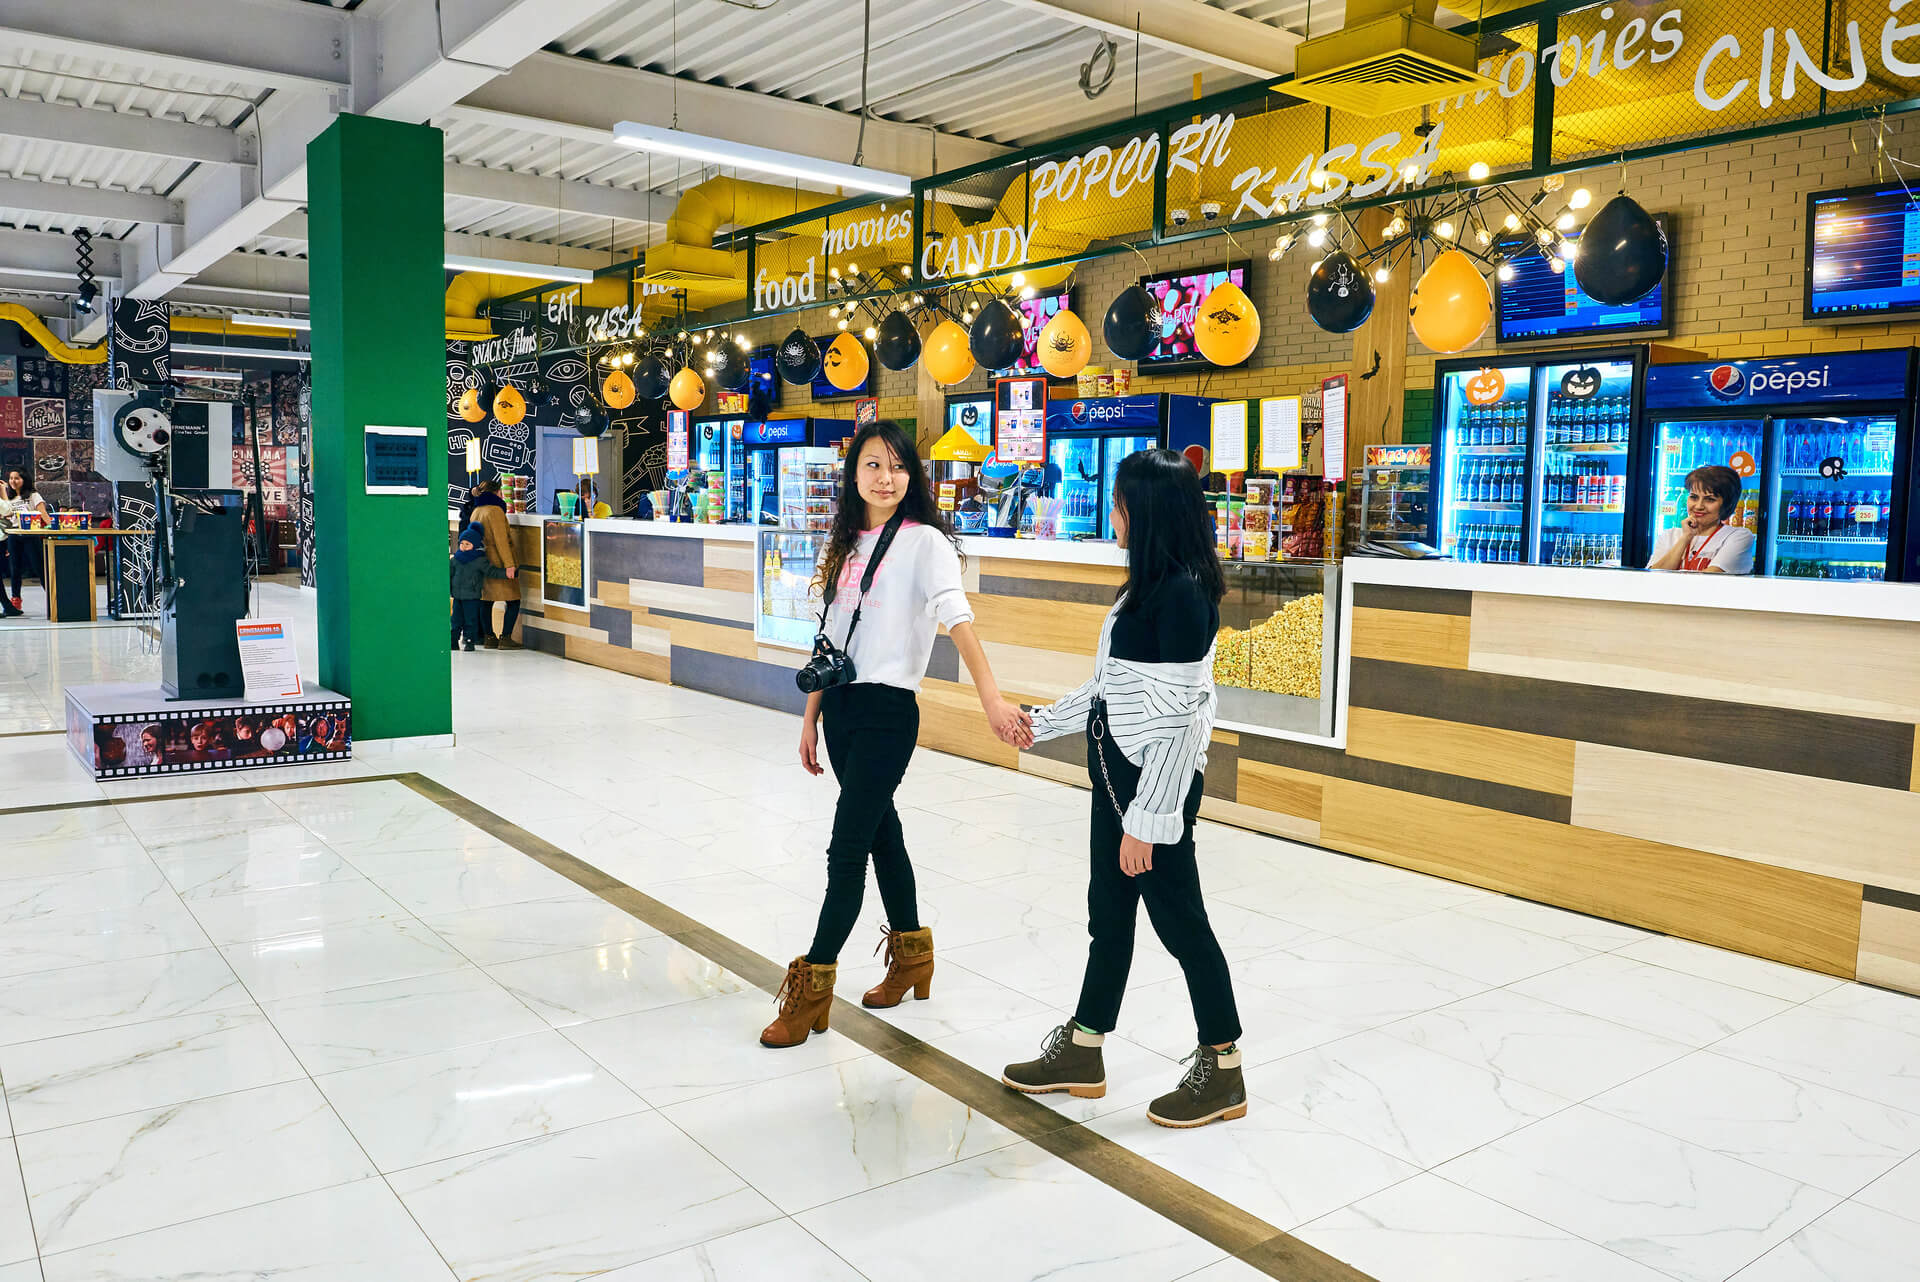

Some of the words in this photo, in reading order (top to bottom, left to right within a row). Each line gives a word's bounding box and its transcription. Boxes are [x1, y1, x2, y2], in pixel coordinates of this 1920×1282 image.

[1031, 112, 1235, 214] POPCORN
[1231, 119, 1445, 221] KASSA
[820, 204, 913, 257] movies
[920, 220, 1038, 280] CANDY
[752, 256, 817, 312] food
[547, 288, 580, 325] EAT
[585, 302, 644, 344] KASSA
[471, 338, 509, 367] SNACKS
[509, 326, 538, 363] films
[1749, 365, 1830, 396] pepsi
[26, 411, 62, 430] CINEMA
[767, 424, 788, 437] pepsi
[1089, 402, 1124, 422] pepsi
[232, 449, 281, 460] CINMA
[1378, 447, 1422, 465] Nachos
